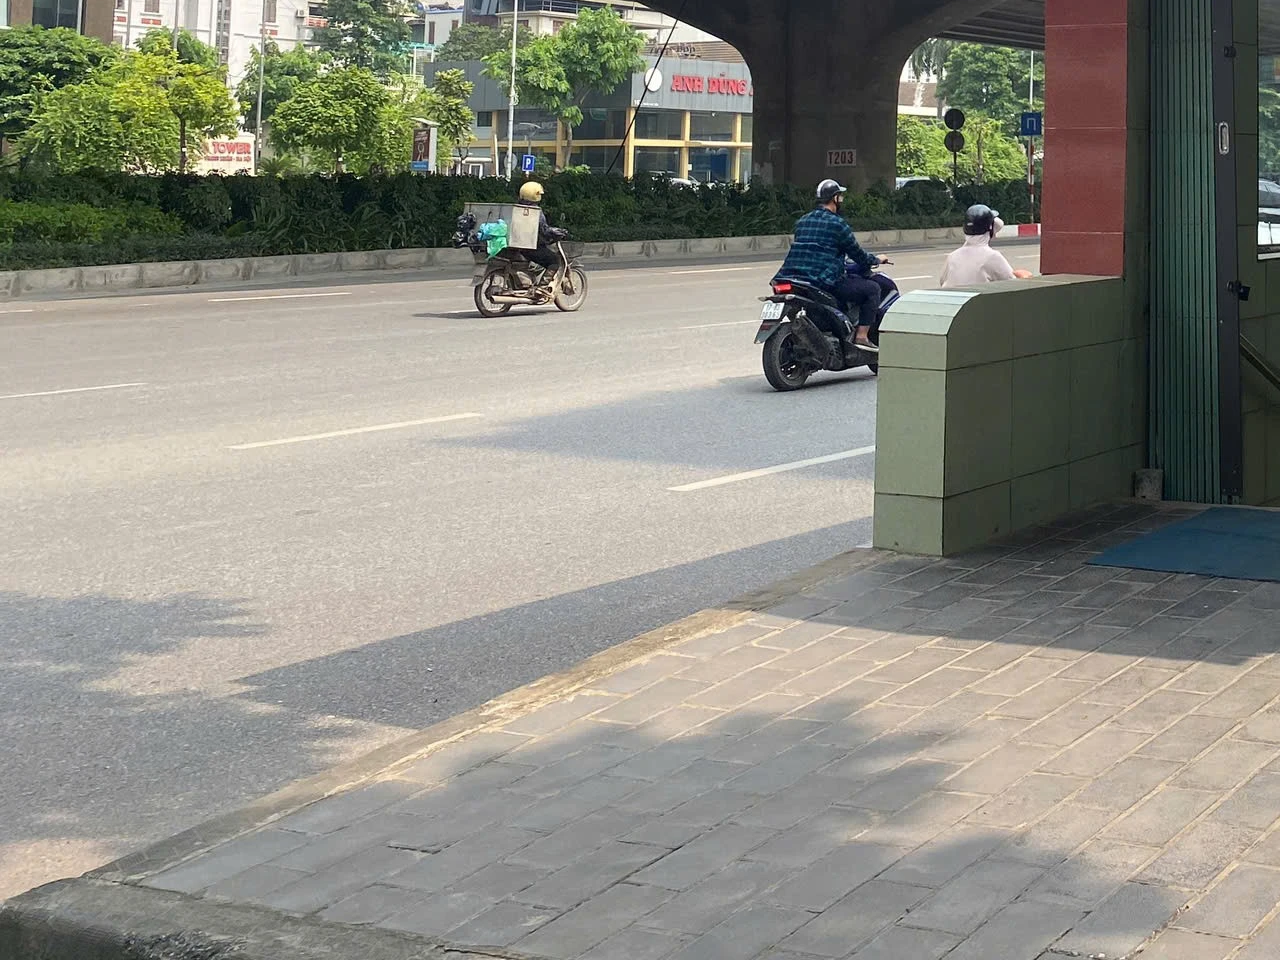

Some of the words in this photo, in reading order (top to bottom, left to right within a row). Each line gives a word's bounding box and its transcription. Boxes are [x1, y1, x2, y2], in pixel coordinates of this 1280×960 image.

[671, 75, 704, 93] ANH
[212, 142, 251, 154] TOWER
[828, 151, 854, 165] T203
